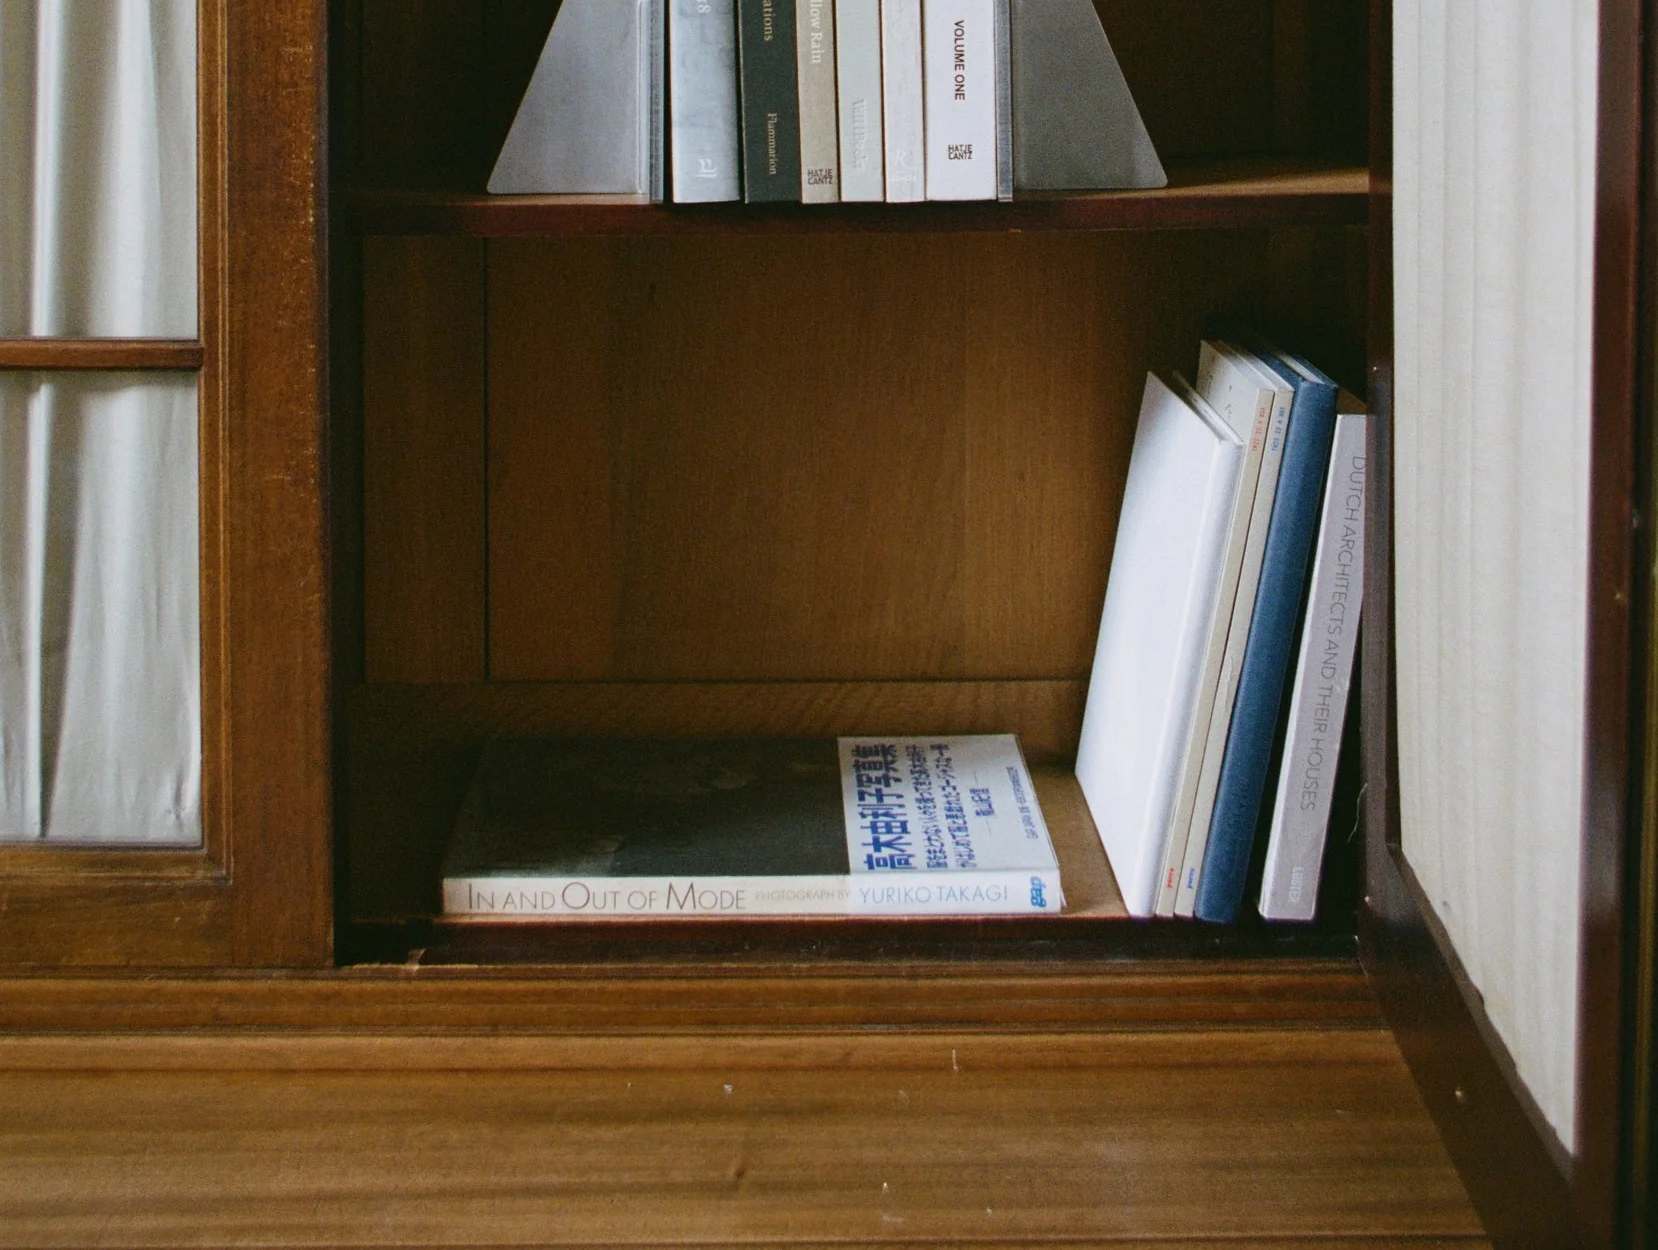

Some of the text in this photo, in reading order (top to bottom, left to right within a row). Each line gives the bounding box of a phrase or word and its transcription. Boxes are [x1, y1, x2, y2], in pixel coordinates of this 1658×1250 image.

[811, 32, 825, 63] Rain
[954, 19, 966, 101] VOLUME ONE
[767, 112, 777, 175] Flammarion
[948, 144, 973, 152] HATJE
[948, 151, 973, 160] CANTZ
[807, 176, 833, 185] CANTZ
[1300, 456, 1366, 812] DUTCH ARCHITECTS AND THEIR HOUSES
[851, 743, 918, 870] 高木由利子写真集
[468, 881, 746, 910] IN AND OUT OF MODE
[836, 889, 850, 900] BY
[859, 885, 933, 904] YURIKO
[937, 884, 1009, 903] TAKAGI
[1030, 876, 1047, 908] gap
